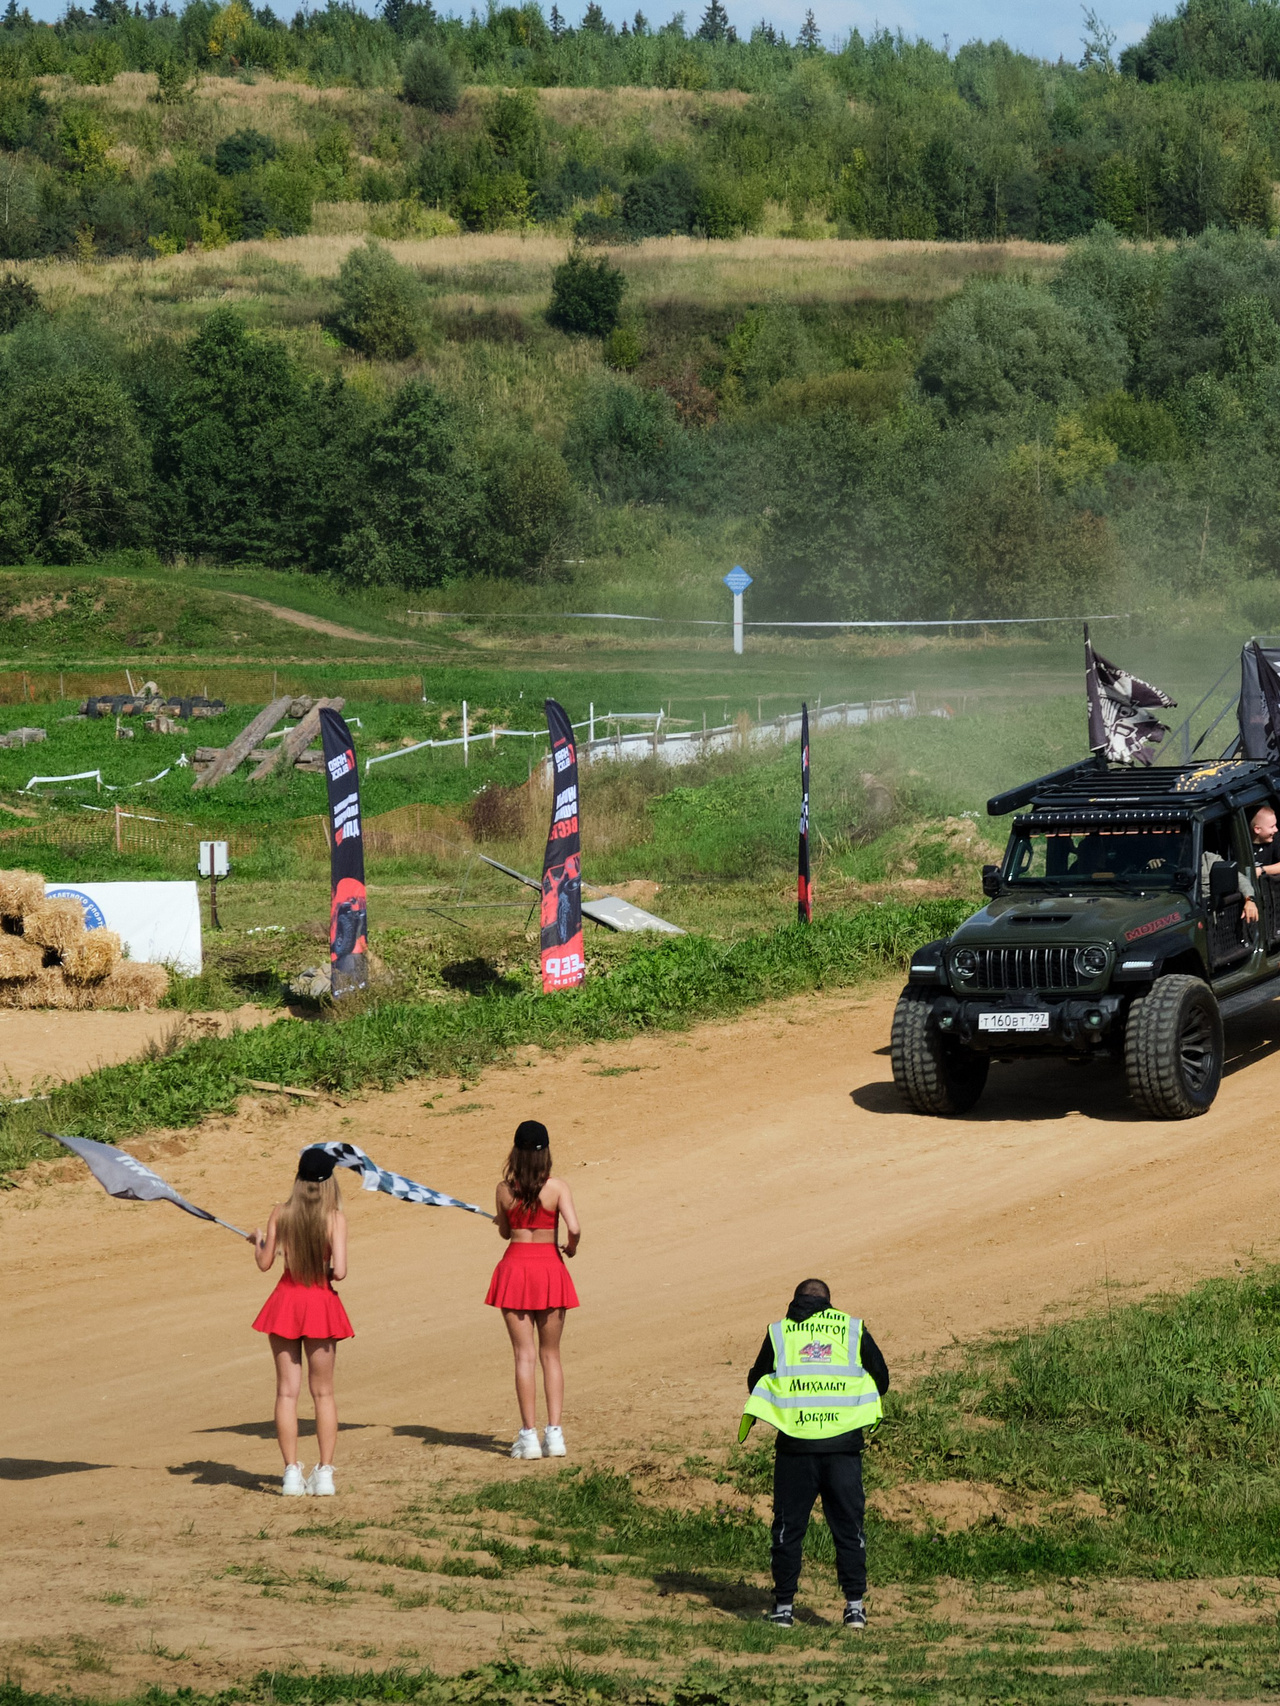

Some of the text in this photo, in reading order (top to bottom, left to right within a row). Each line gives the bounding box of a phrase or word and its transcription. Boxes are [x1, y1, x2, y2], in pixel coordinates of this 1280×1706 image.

[88, 904, 104, 926] СПОРТ
[1125, 912, 1181, 941] MOJAVE
[1029, 1014, 1045, 1023] 797
[789, 1379, 846, 1393] Михалыч
[795, 1410, 840, 1429] Добряк
